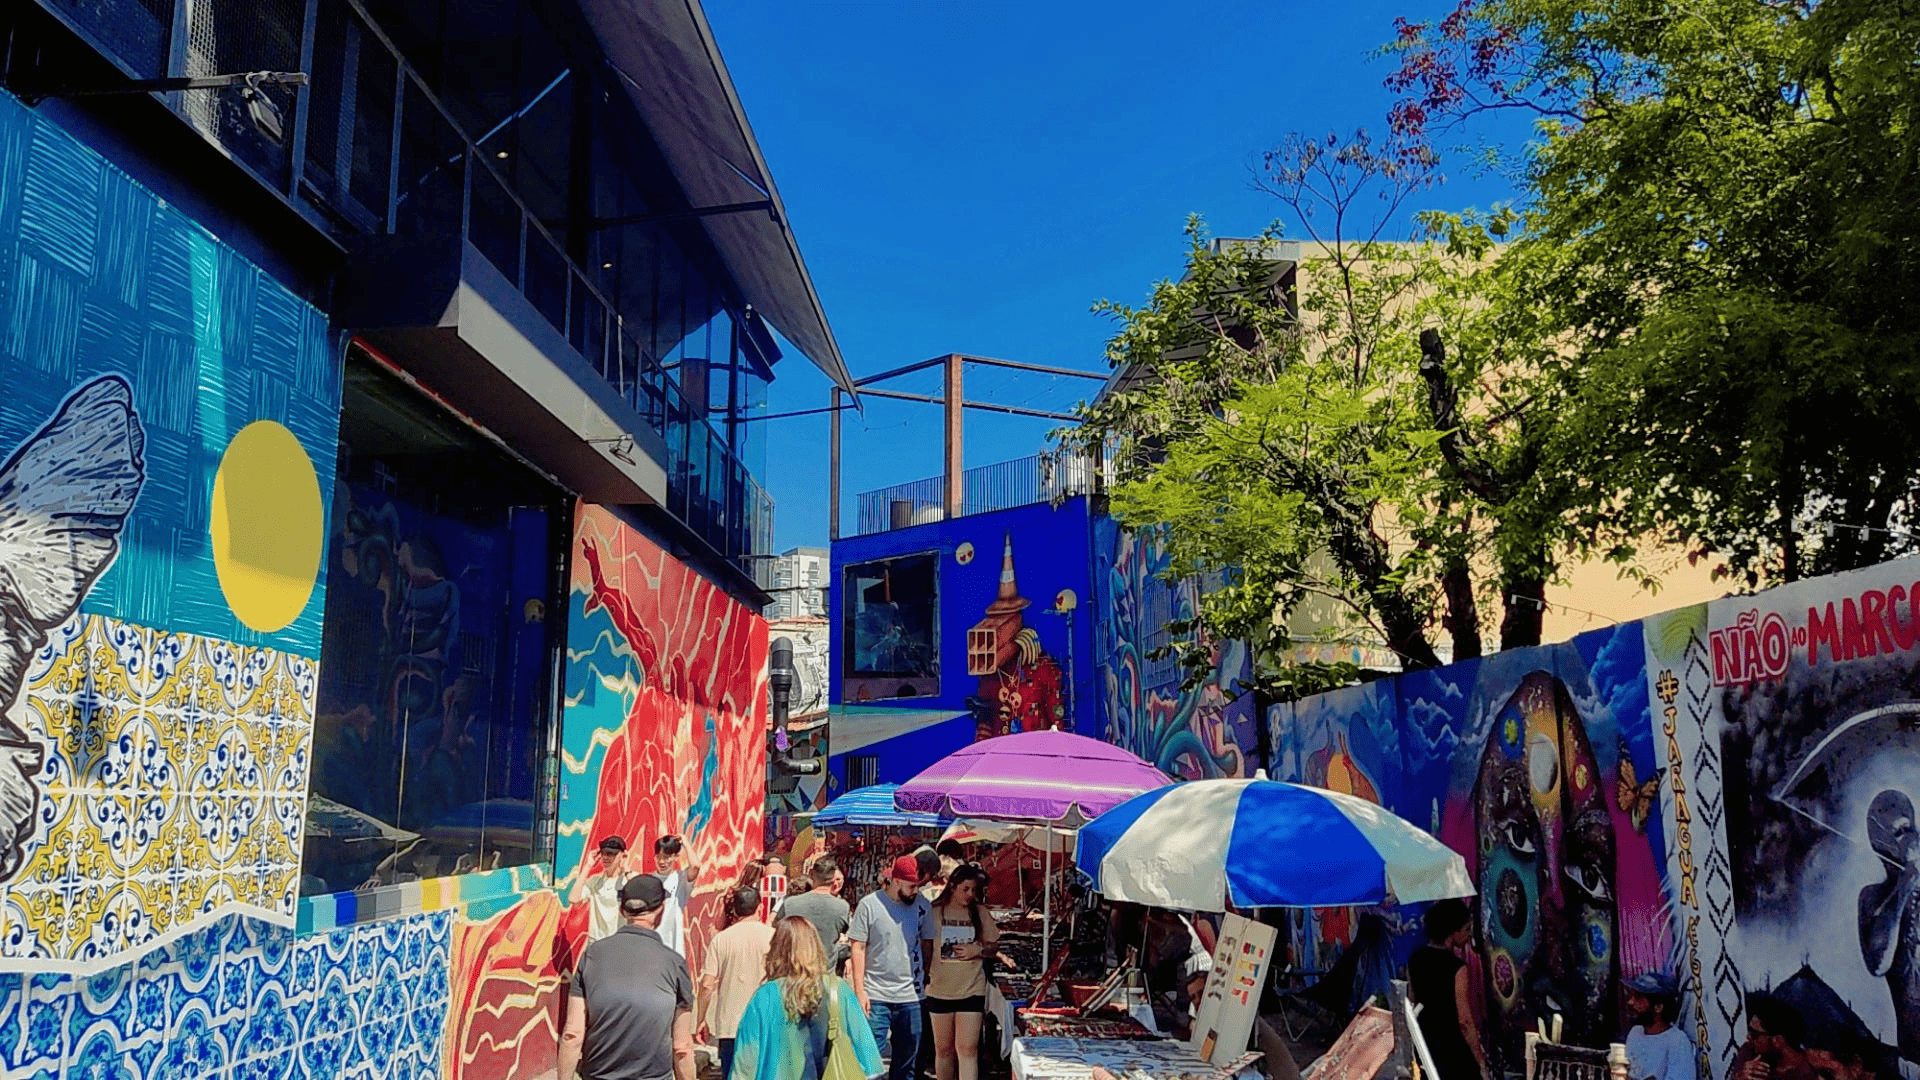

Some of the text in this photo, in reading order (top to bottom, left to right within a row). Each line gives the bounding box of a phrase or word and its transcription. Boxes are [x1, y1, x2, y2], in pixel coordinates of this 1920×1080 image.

[1710, 608, 1791, 687] NÃO
[1791, 626, 1807, 648] AO
[1656, 669, 1699, 910] #JARAGUÁ
